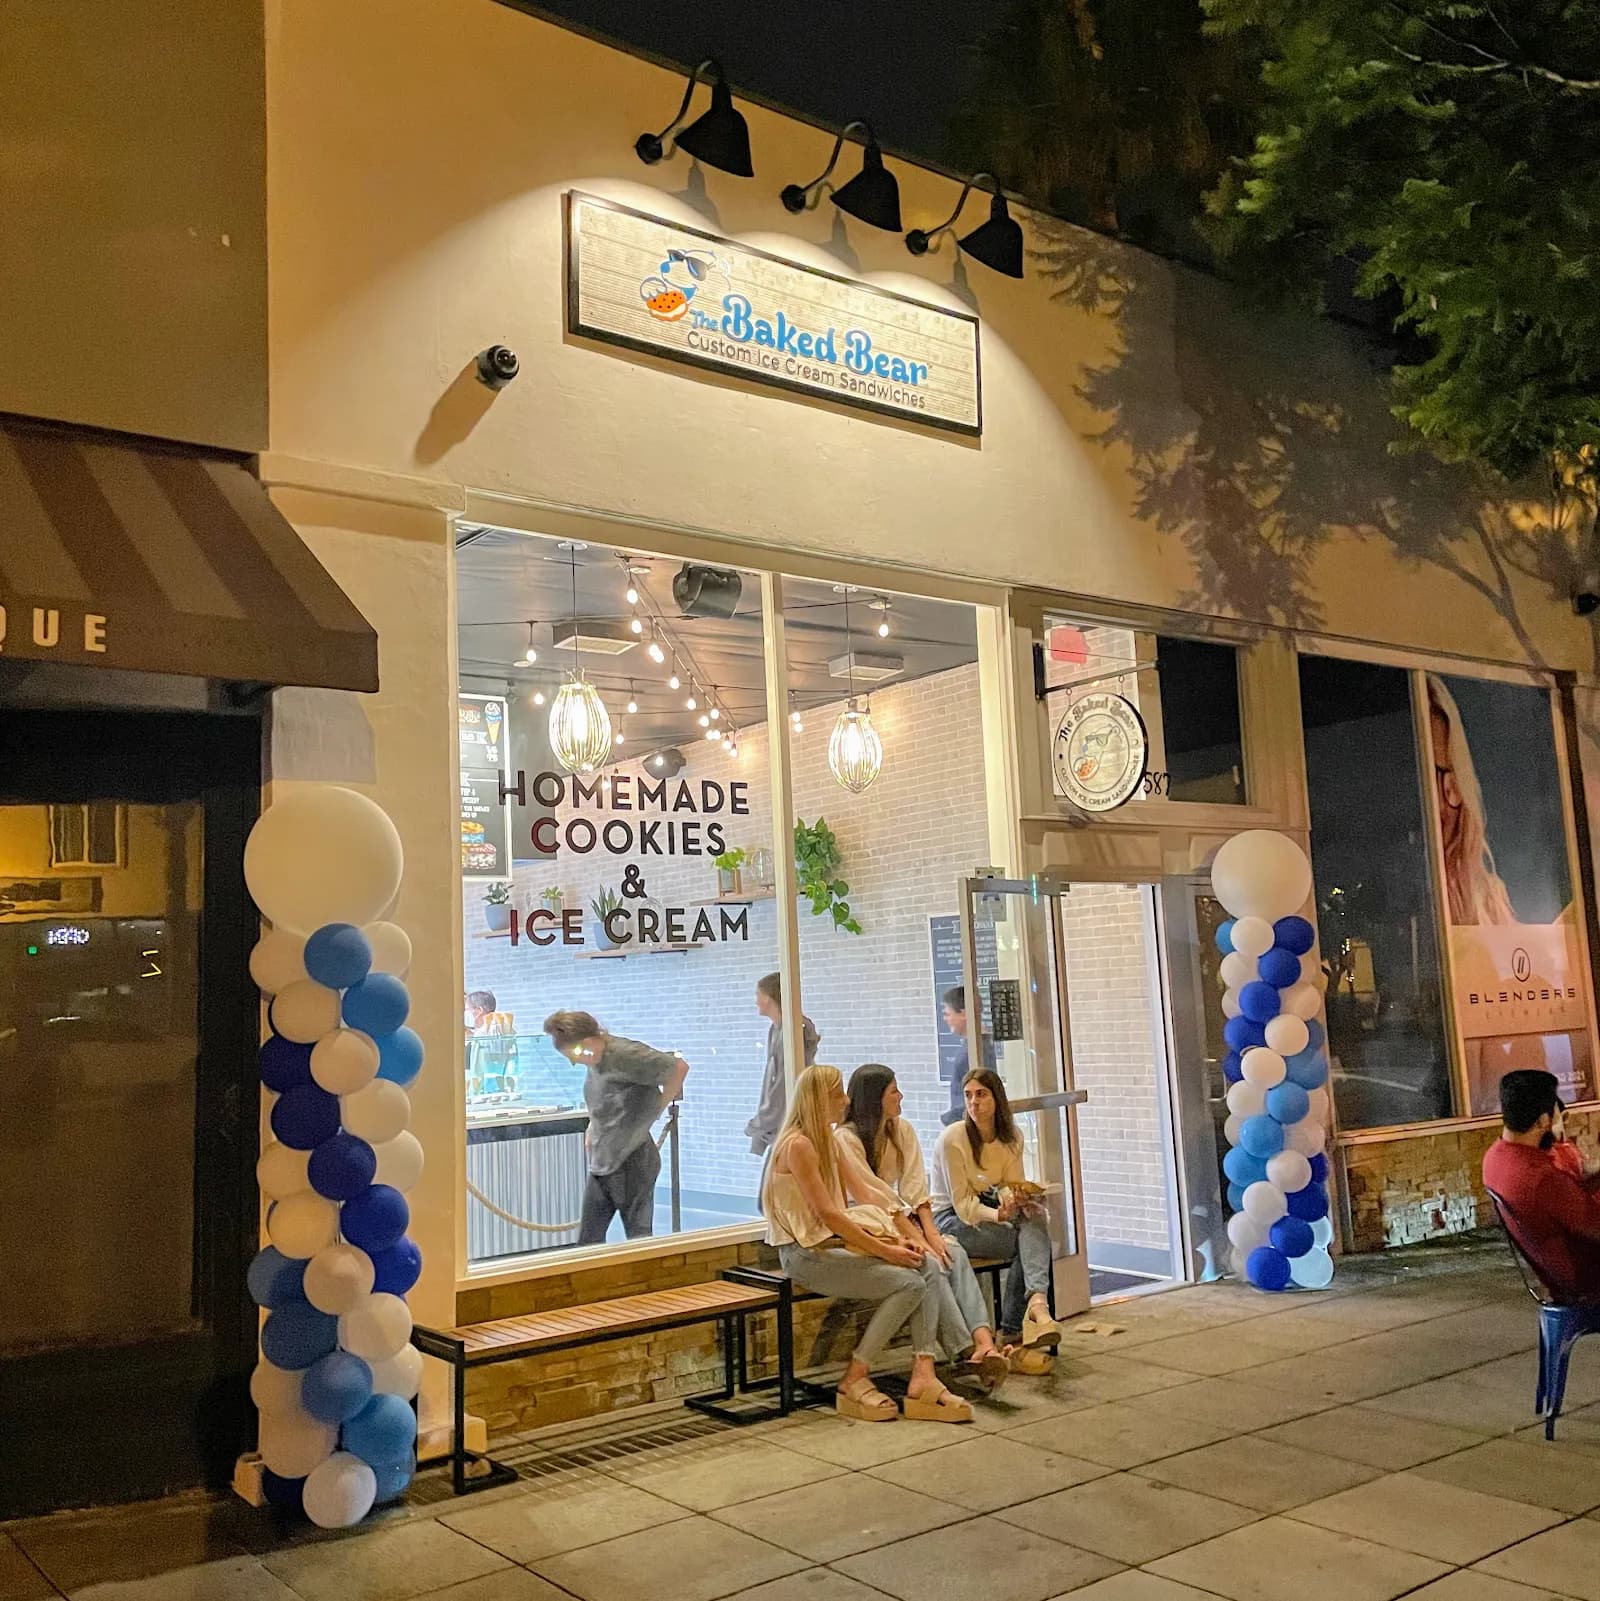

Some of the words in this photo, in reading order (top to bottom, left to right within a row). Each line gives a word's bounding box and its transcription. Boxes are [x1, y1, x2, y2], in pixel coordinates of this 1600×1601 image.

[689, 308, 719, 332] The
[721, 293, 838, 365] Baked
[844, 329, 928, 386] Bear
[687, 330, 752, 362] Custom
[755, 348, 780, 371] Ice
[785, 357, 835, 387] Cream
[839, 371, 926, 409] Sandwiches
[0, 604, 107, 653] UE
[498, 769, 750, 815] HOMEMADE
[1143, 771, 1171, 796] 587
[531, 816, 726, 857] COOKIES
[621, 864, 648, 899] &
[509, 908, 586, 947] ICE
[603, 907, 750, 944] CREAM
[1469, 987, 1576, 1005] BLENDERS
